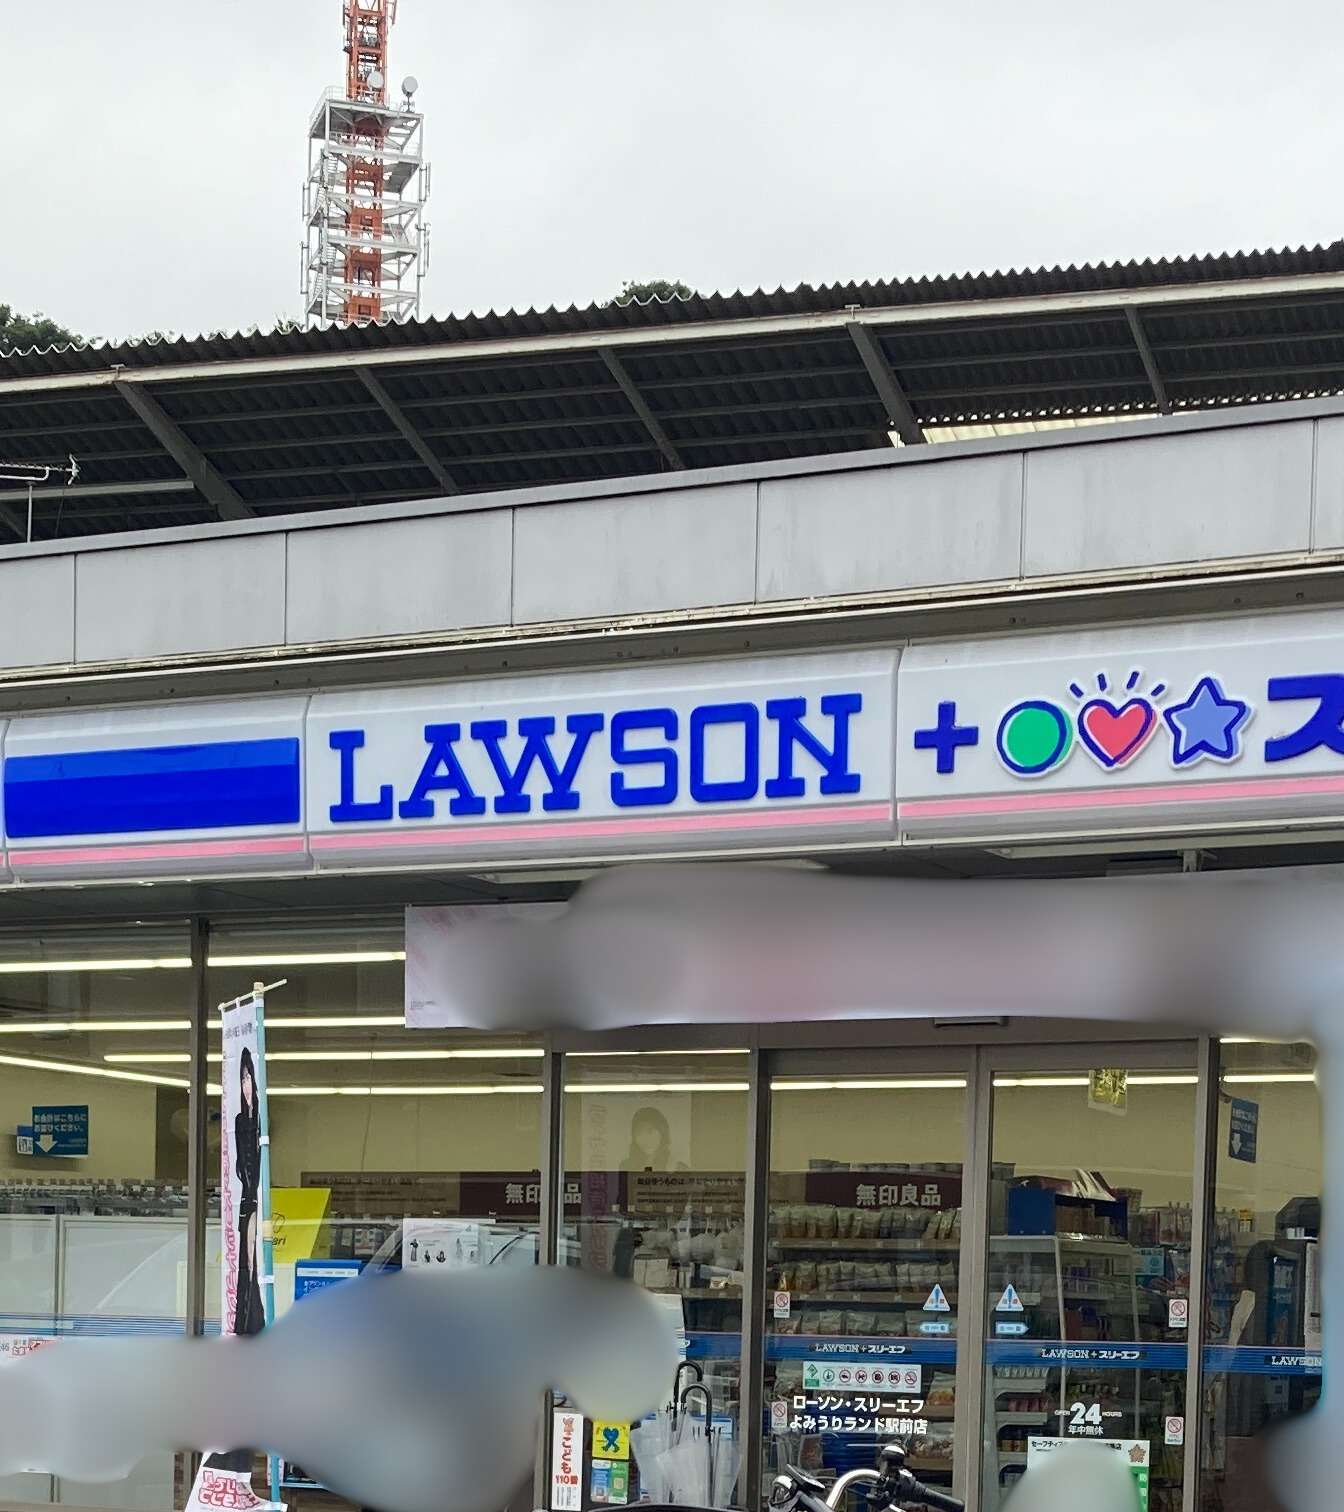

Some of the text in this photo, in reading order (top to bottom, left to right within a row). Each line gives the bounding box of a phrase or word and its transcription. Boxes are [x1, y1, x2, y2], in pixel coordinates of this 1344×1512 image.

[329, 693, 863, 822] LAWSON
[856, 1184, 941, 1206] 無印良品
[814, 1342, 860, 1354] LAWSON
[868, 1345, 906, 1354] スリーエフ
[1041, 1349, 1089, 1359] LAWSON
[1098, 1350, 1140, 1360] スリーエフ
[793, 1395, 925, 1414] ローソン・スリーエフ
[1070, 1402, 1102, 1425] 24
[790, 1414, 928, 1435] よみうりランド駅前店
[1068, 1425, 1104, 1436] 年中無休
